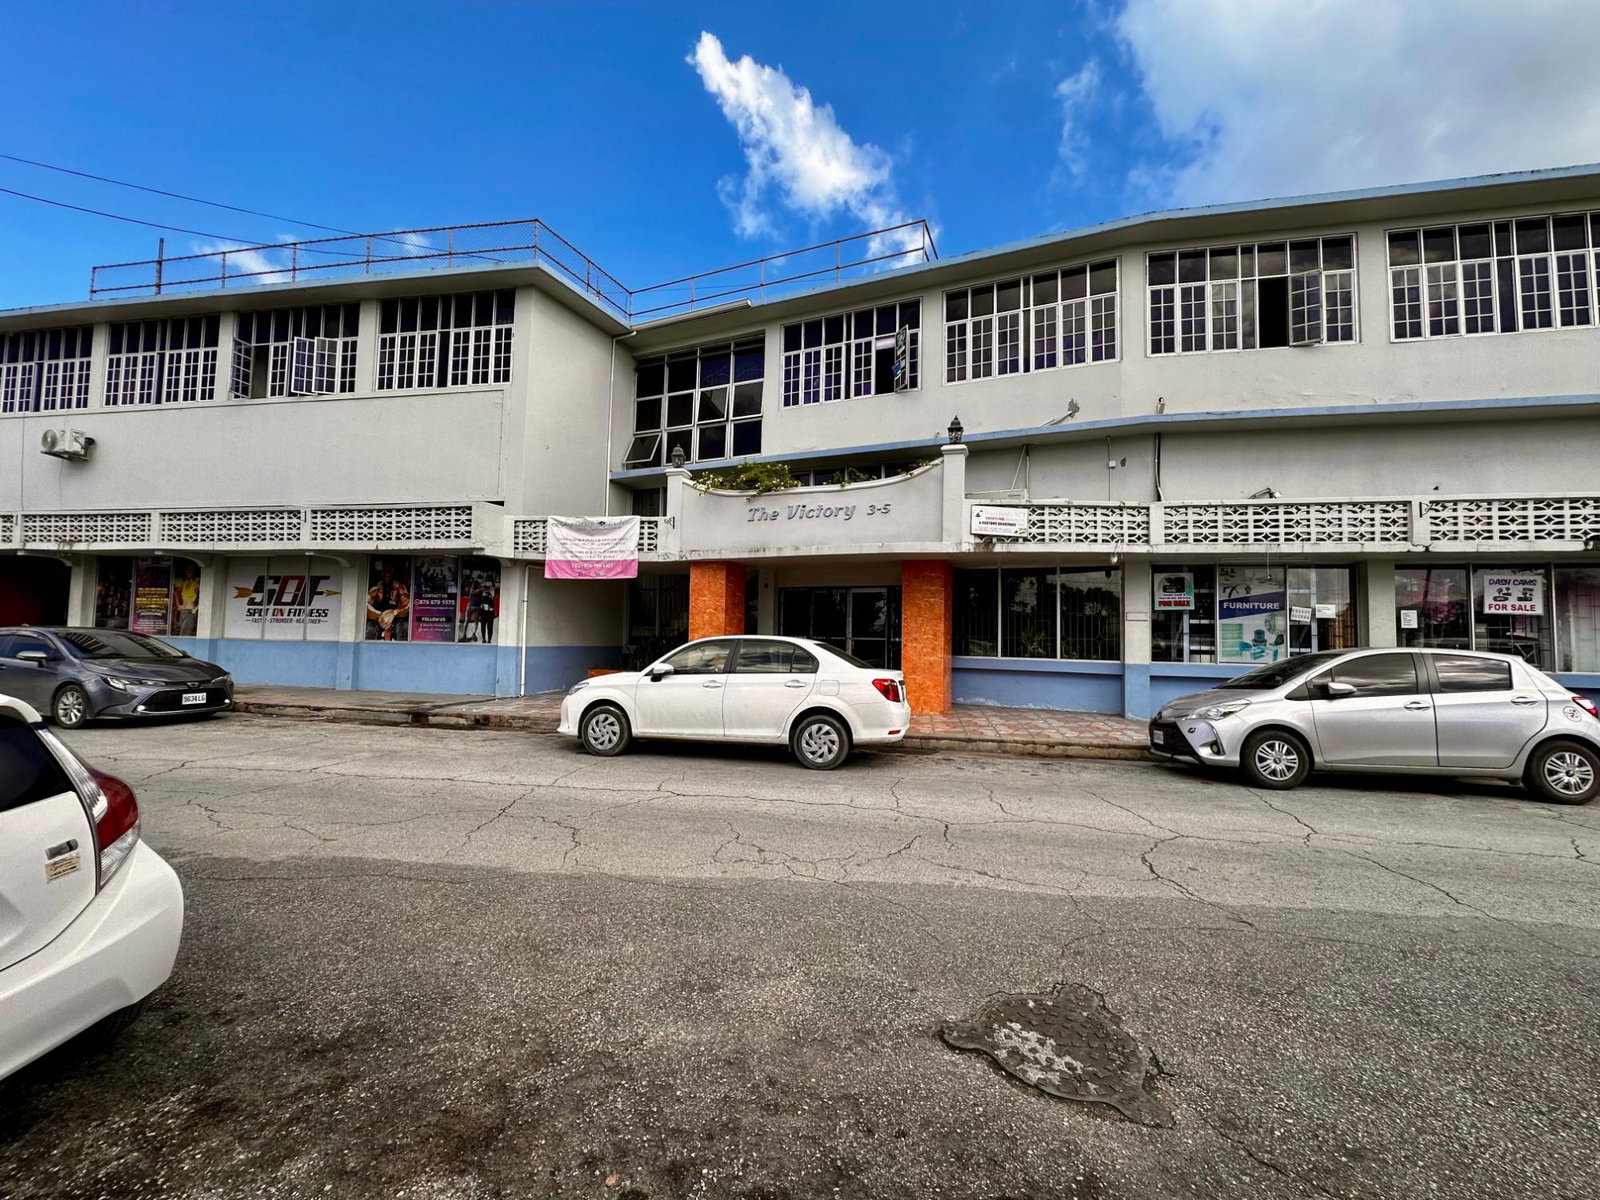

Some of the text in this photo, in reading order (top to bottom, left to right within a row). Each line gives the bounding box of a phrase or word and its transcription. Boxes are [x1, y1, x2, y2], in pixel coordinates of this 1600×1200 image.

[747, 503, 891, 522] The Victory 3-5
[1488, 578, 1537, 586] DASH CAMS
[246, 575, 331, 606] SOF
[1223, 602, 1280, 610] FURNITURE
[1488, 603, 1536, 612] FOR SALE
[272, 608, 286, 617] ON
